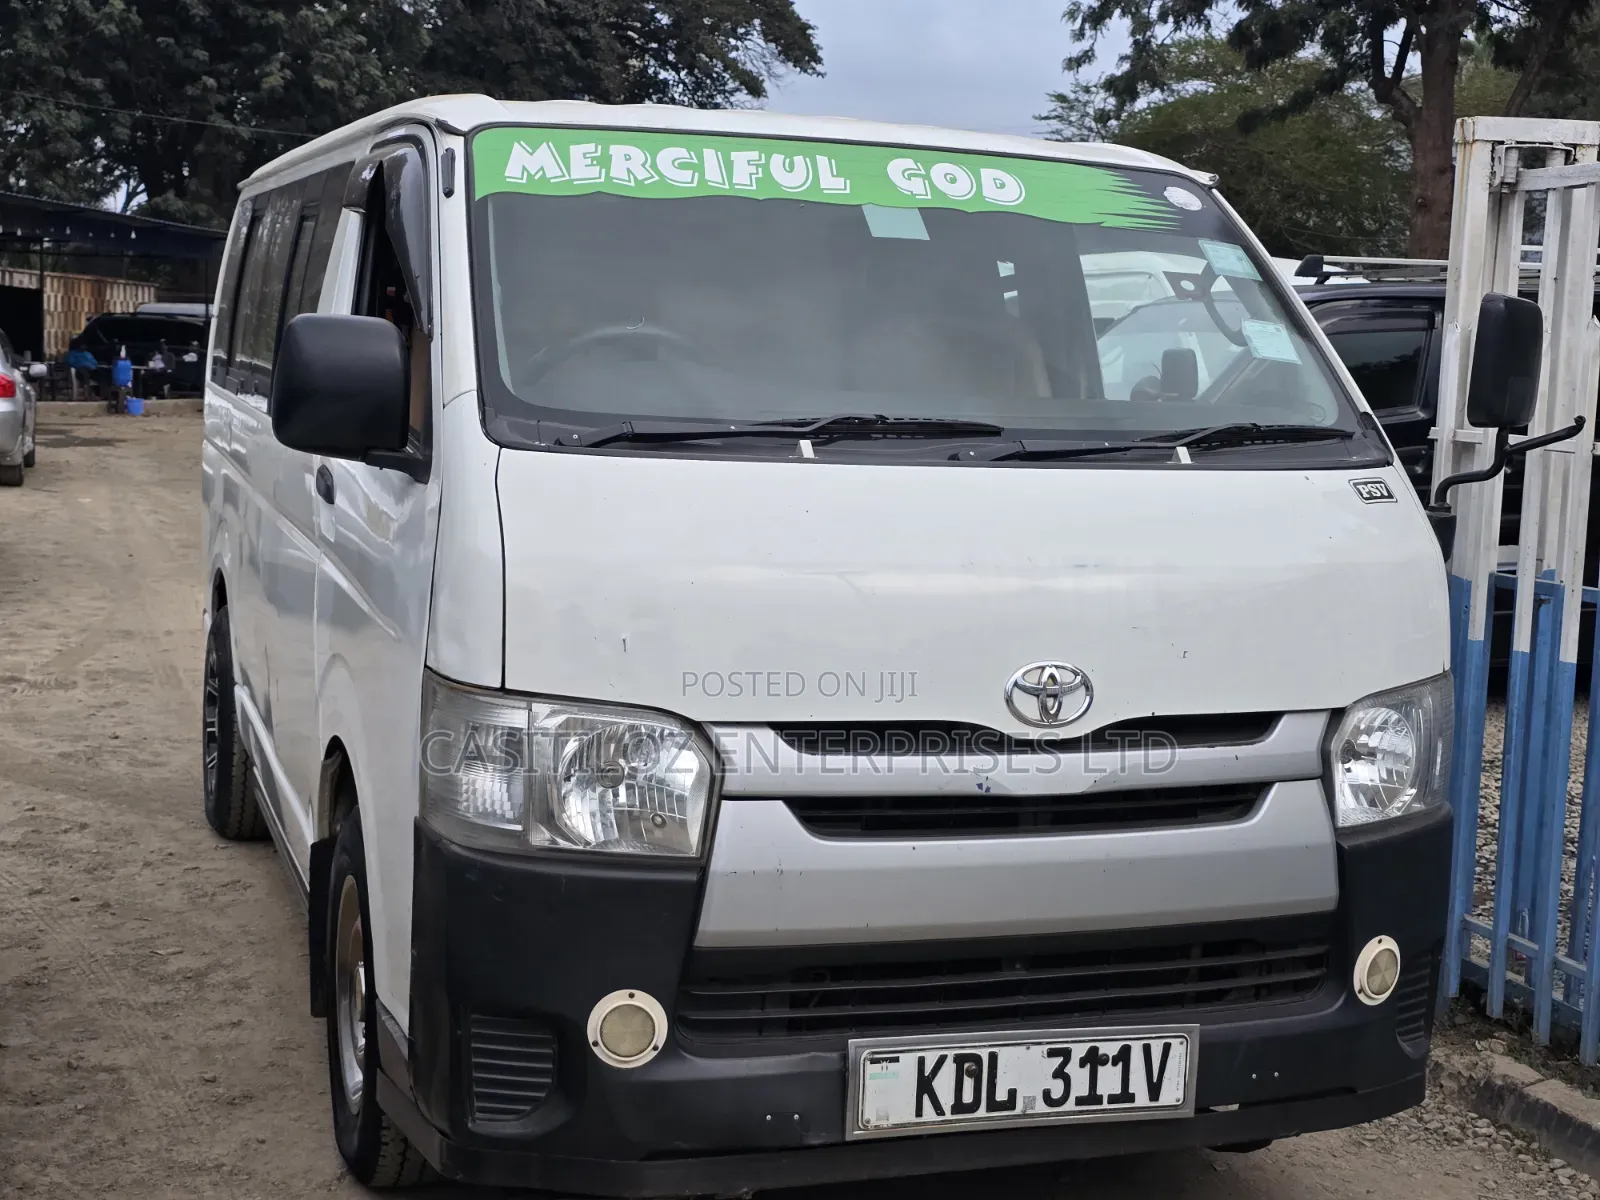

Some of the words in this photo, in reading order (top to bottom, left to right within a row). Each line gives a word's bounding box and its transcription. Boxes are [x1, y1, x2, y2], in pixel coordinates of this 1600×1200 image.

[504, 140, 851, 194] MERCIFUL
[886, 157, 1026, 206] GOD
[1356, 484, 1388, 498] PSV
[915, 1051, 1018, 1118] KDL
[1042, 1042, 1172, 1108] 311V
